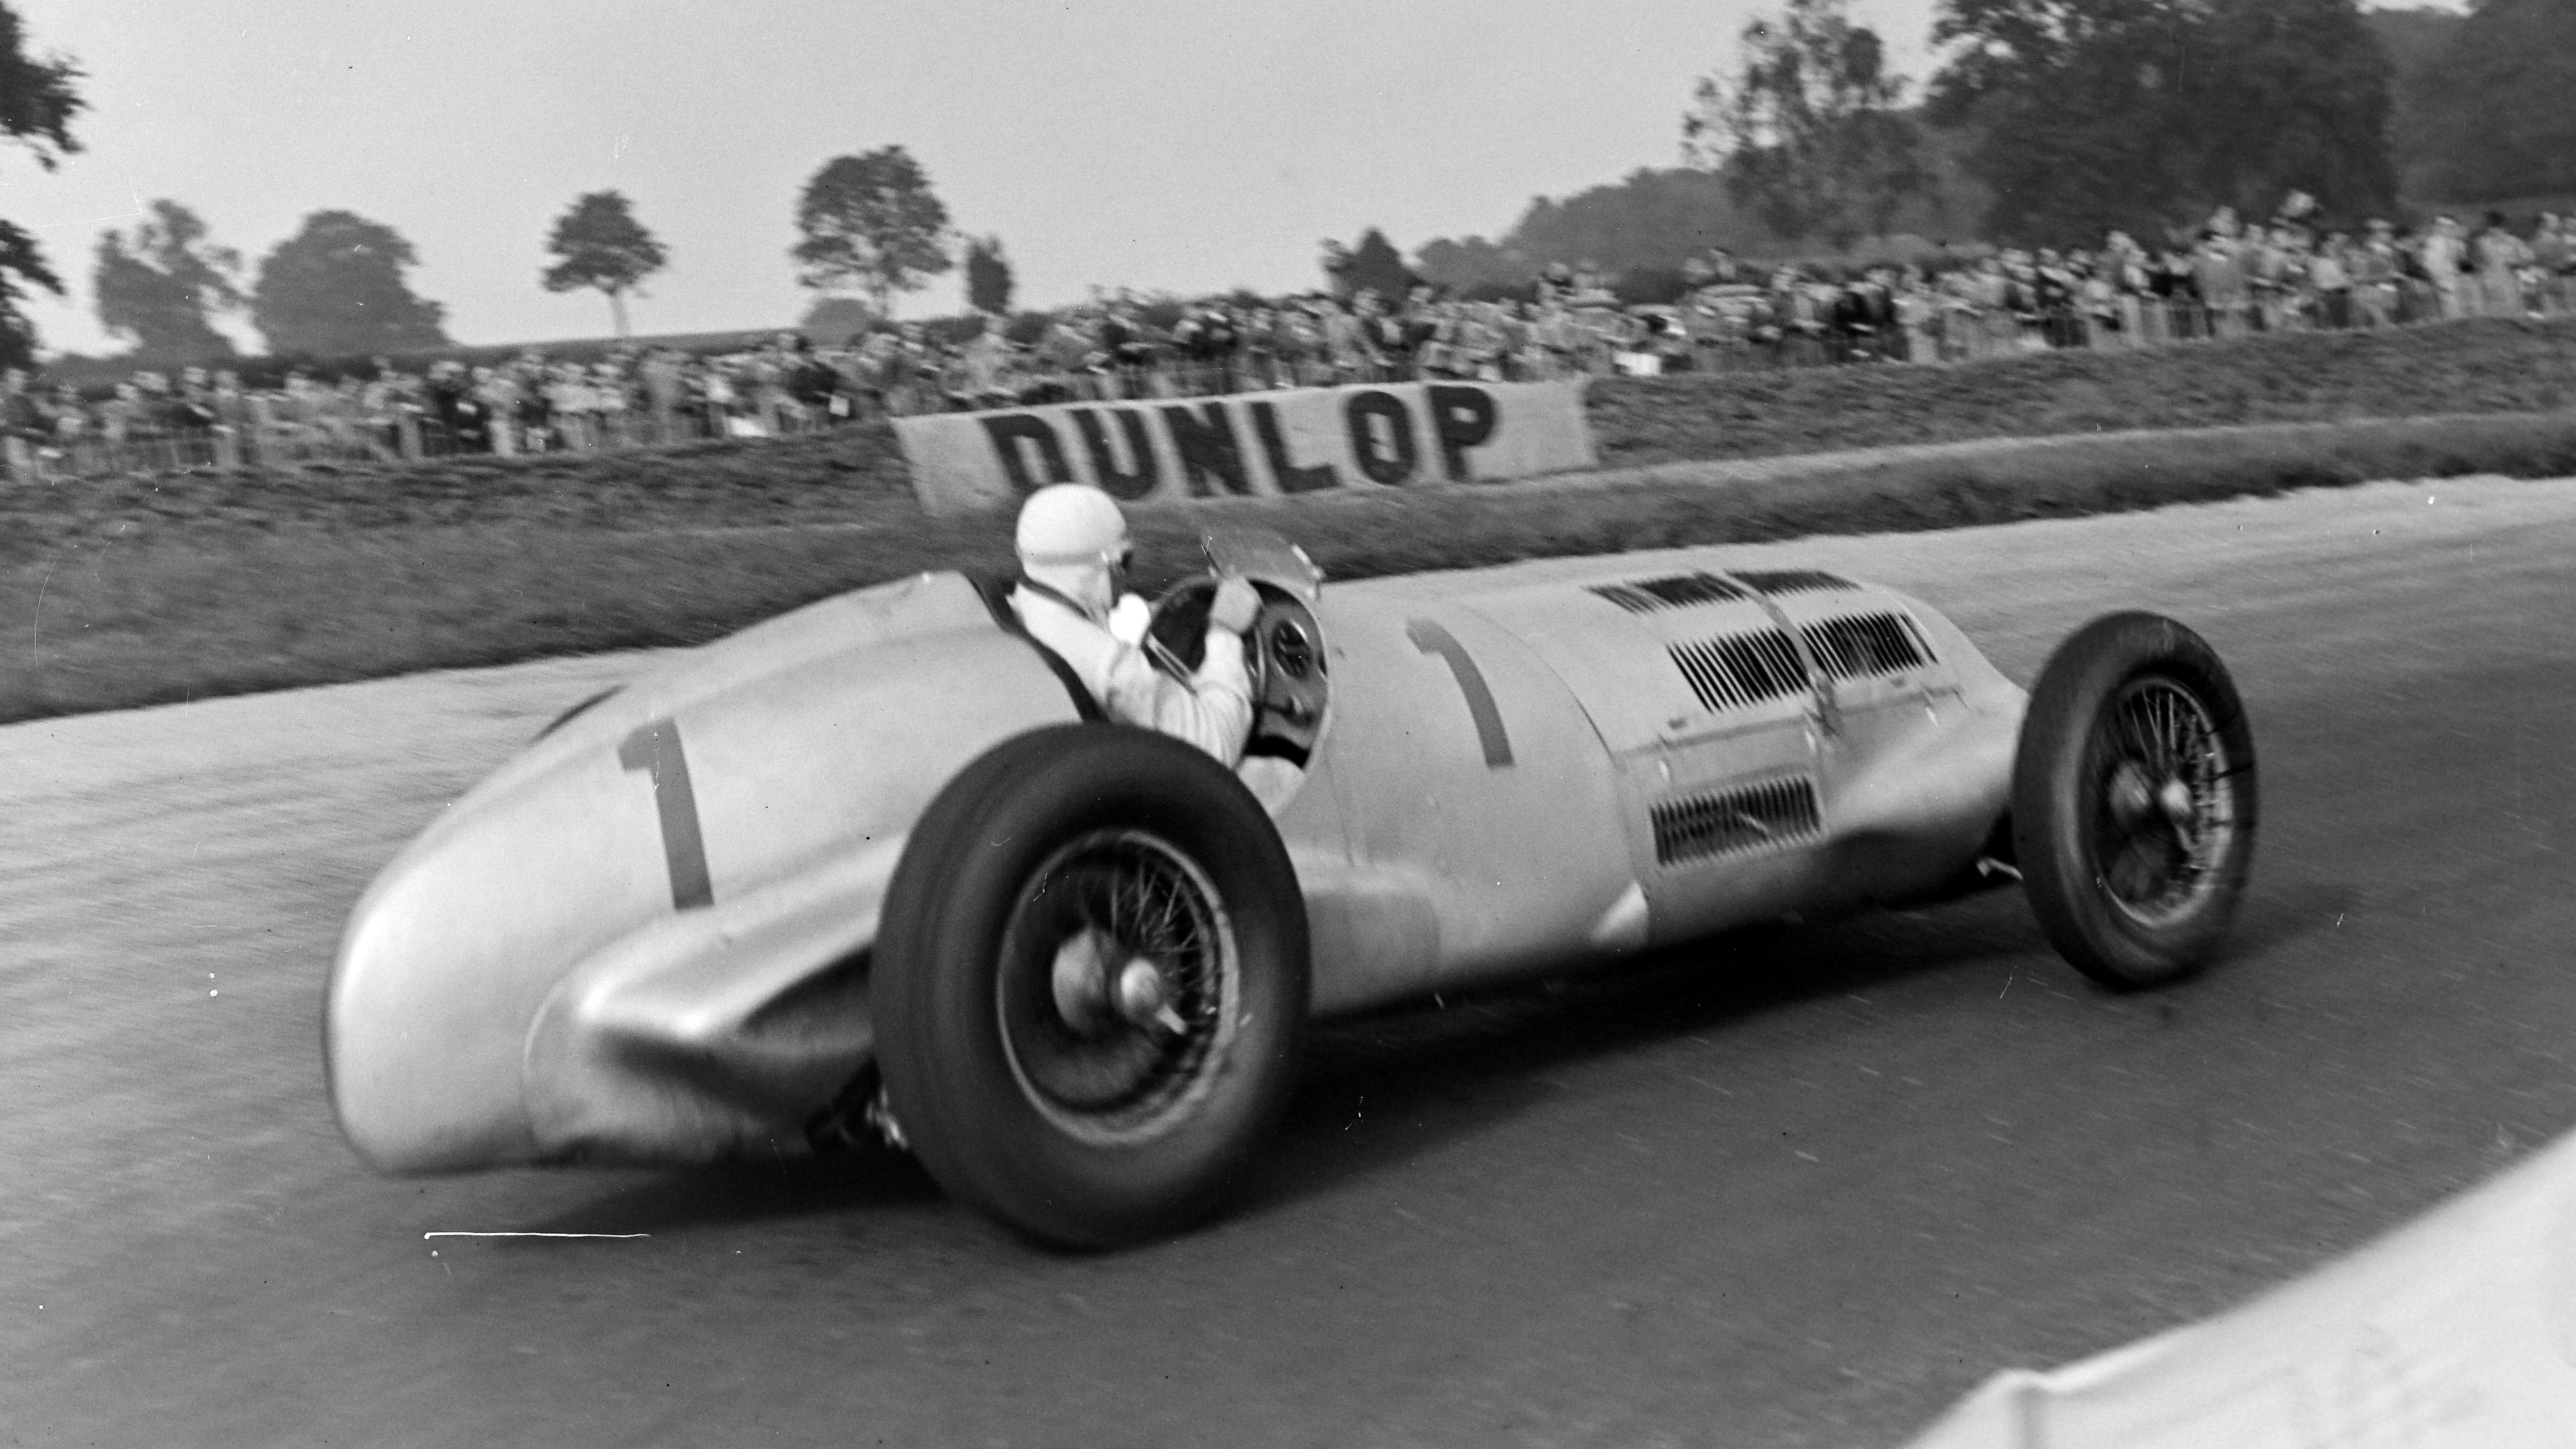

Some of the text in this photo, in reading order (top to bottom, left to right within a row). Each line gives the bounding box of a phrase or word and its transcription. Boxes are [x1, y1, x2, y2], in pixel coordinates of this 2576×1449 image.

[977, 385, 1498, 501] DUNLOP
[1406, 618, 1514, 769] 1
[617, 717, 714, 910] 1
